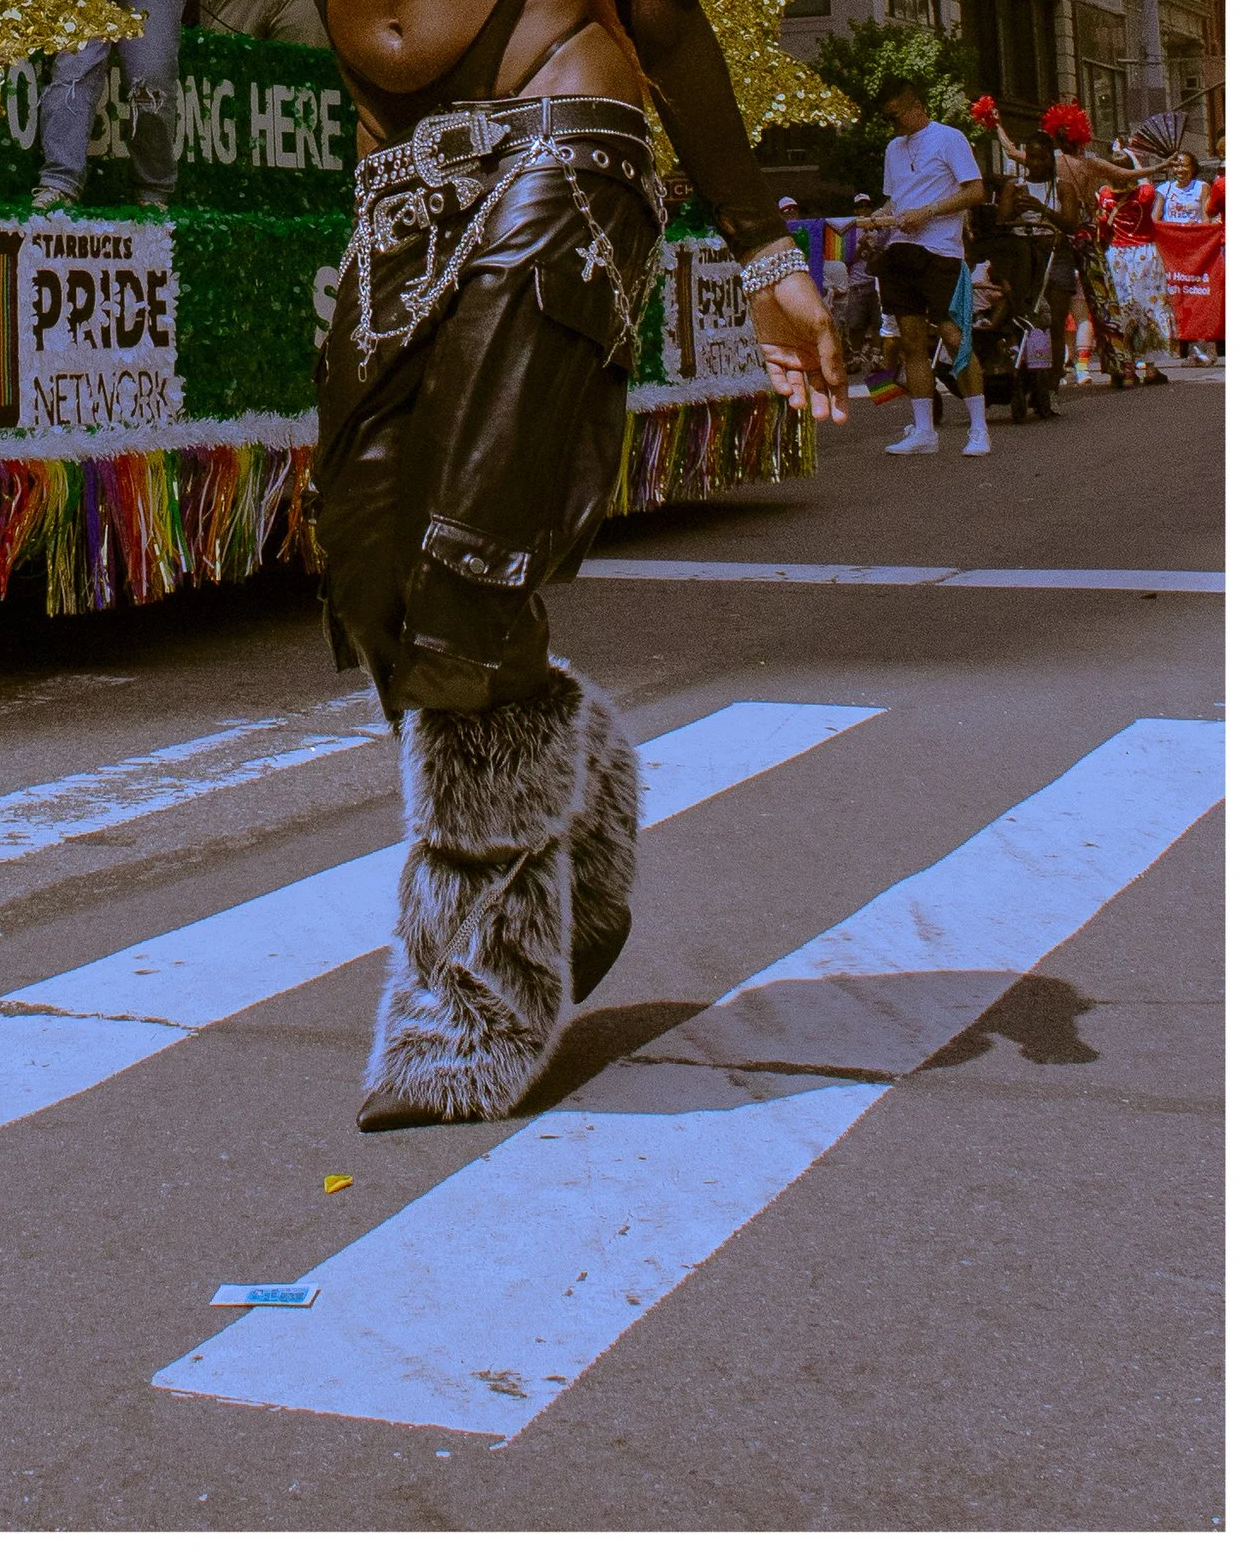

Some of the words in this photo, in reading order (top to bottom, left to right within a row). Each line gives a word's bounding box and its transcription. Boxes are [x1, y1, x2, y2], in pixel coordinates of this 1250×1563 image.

[250, 81, 343, 171] HERE
[32, 233, 133, 260] STARBUCKS
[32, 269, 170, 352] PRIDE
[1182, 285, 1211, 295] School
[33, 369, 168, 426] NETWORK
